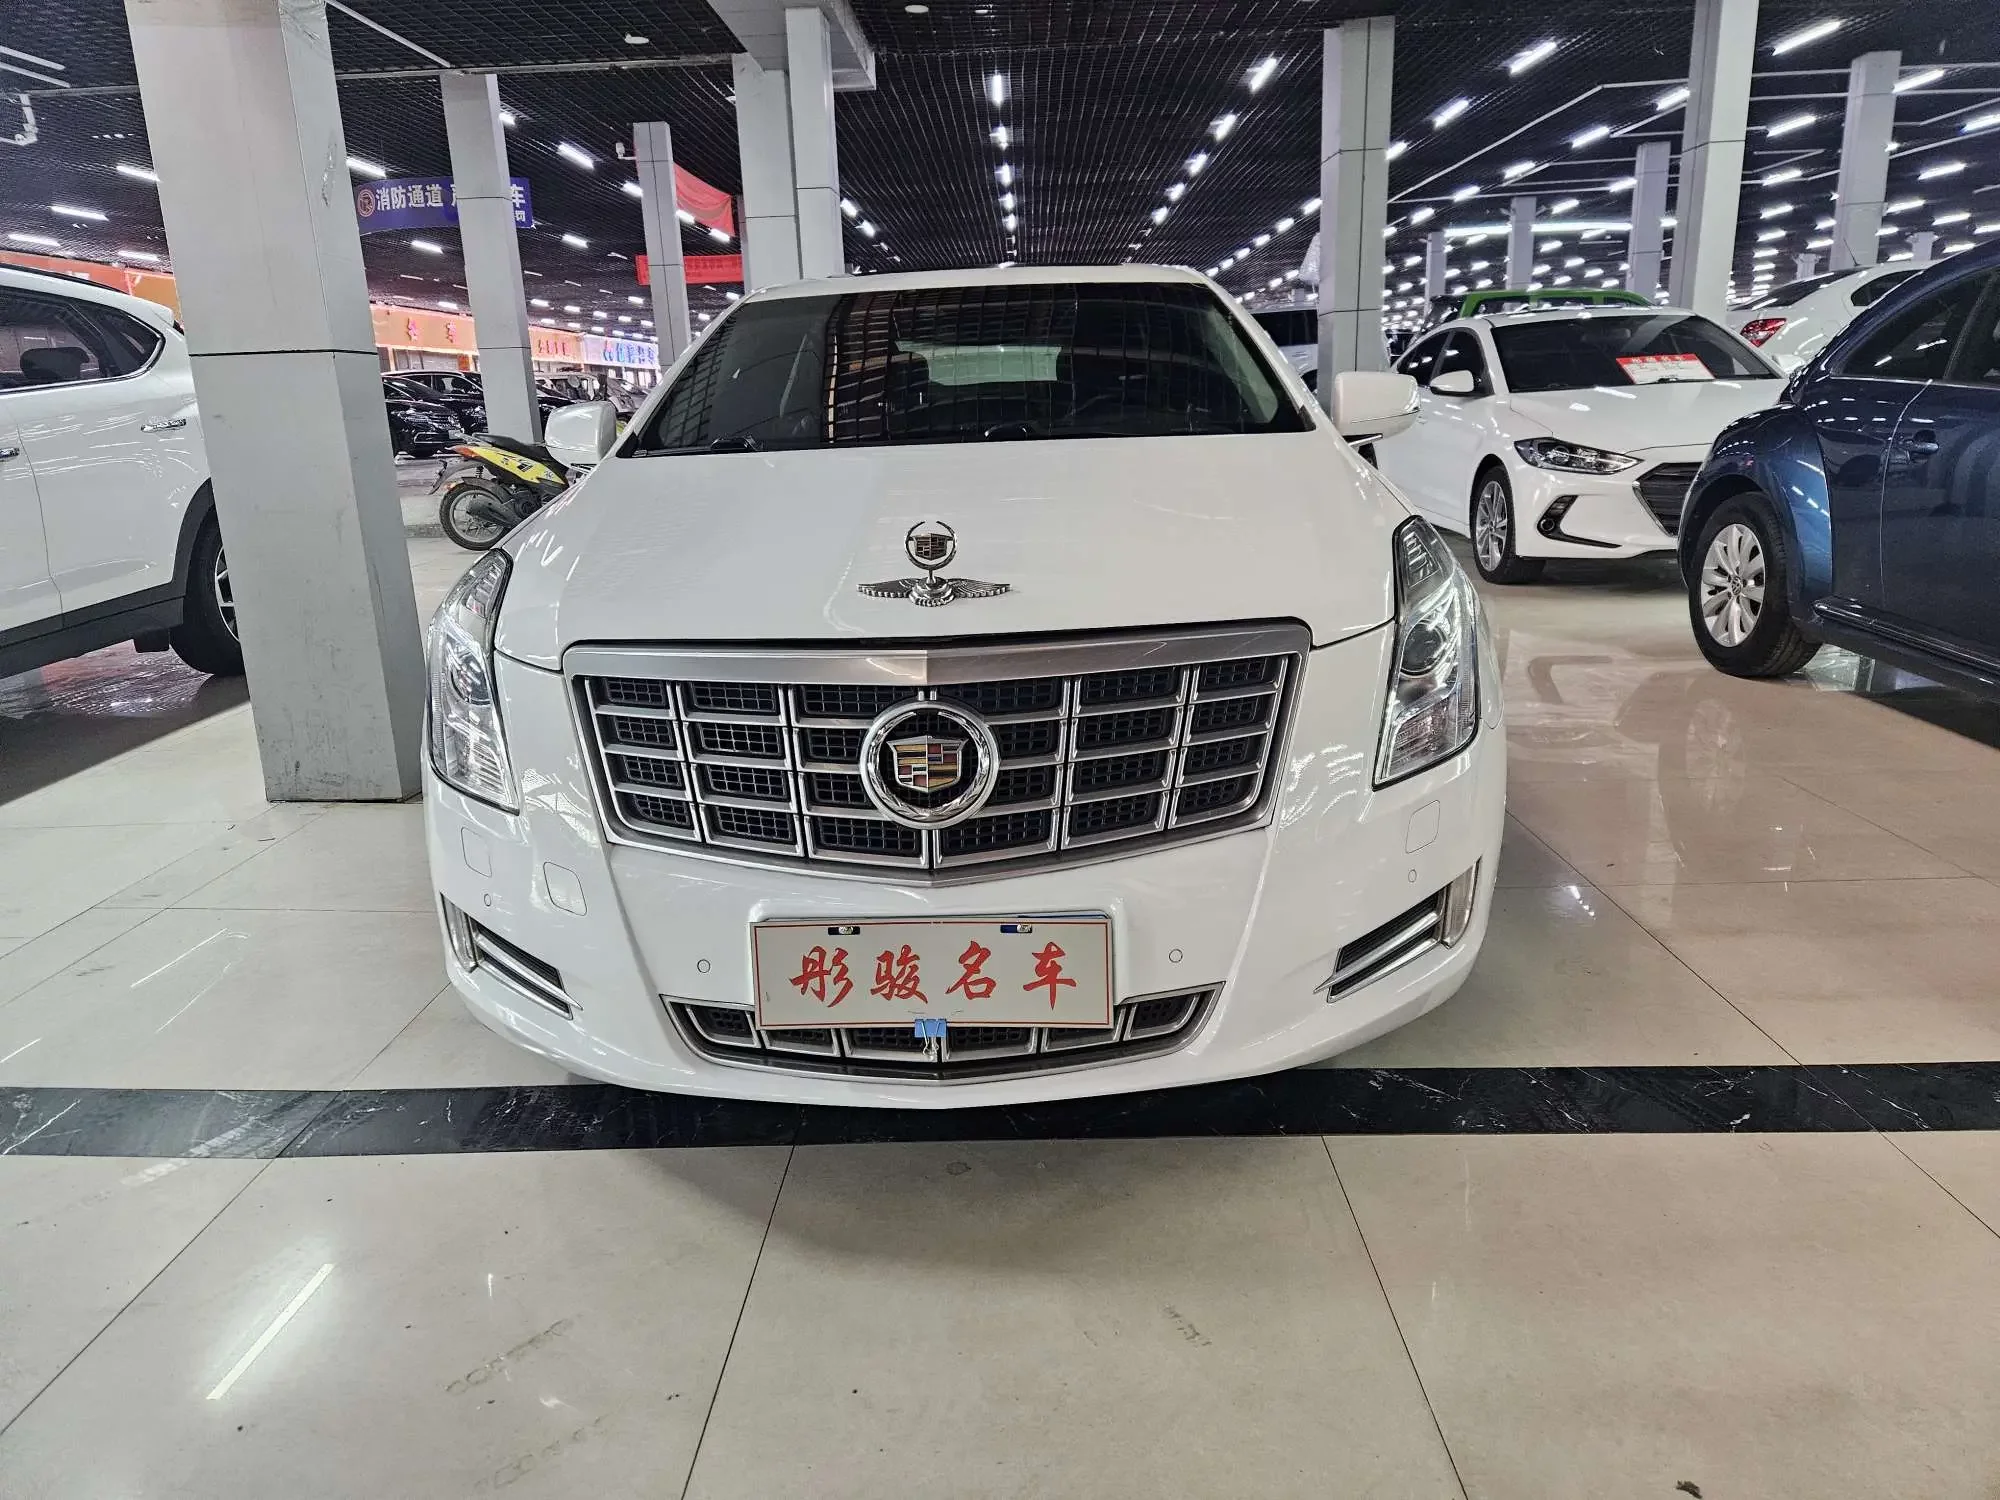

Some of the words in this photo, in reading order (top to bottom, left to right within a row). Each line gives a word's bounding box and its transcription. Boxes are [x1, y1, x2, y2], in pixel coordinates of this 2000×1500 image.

[376, 184, 443, 211] 消防通道
[790, 940, 1077, 1010] 彤骏名车
